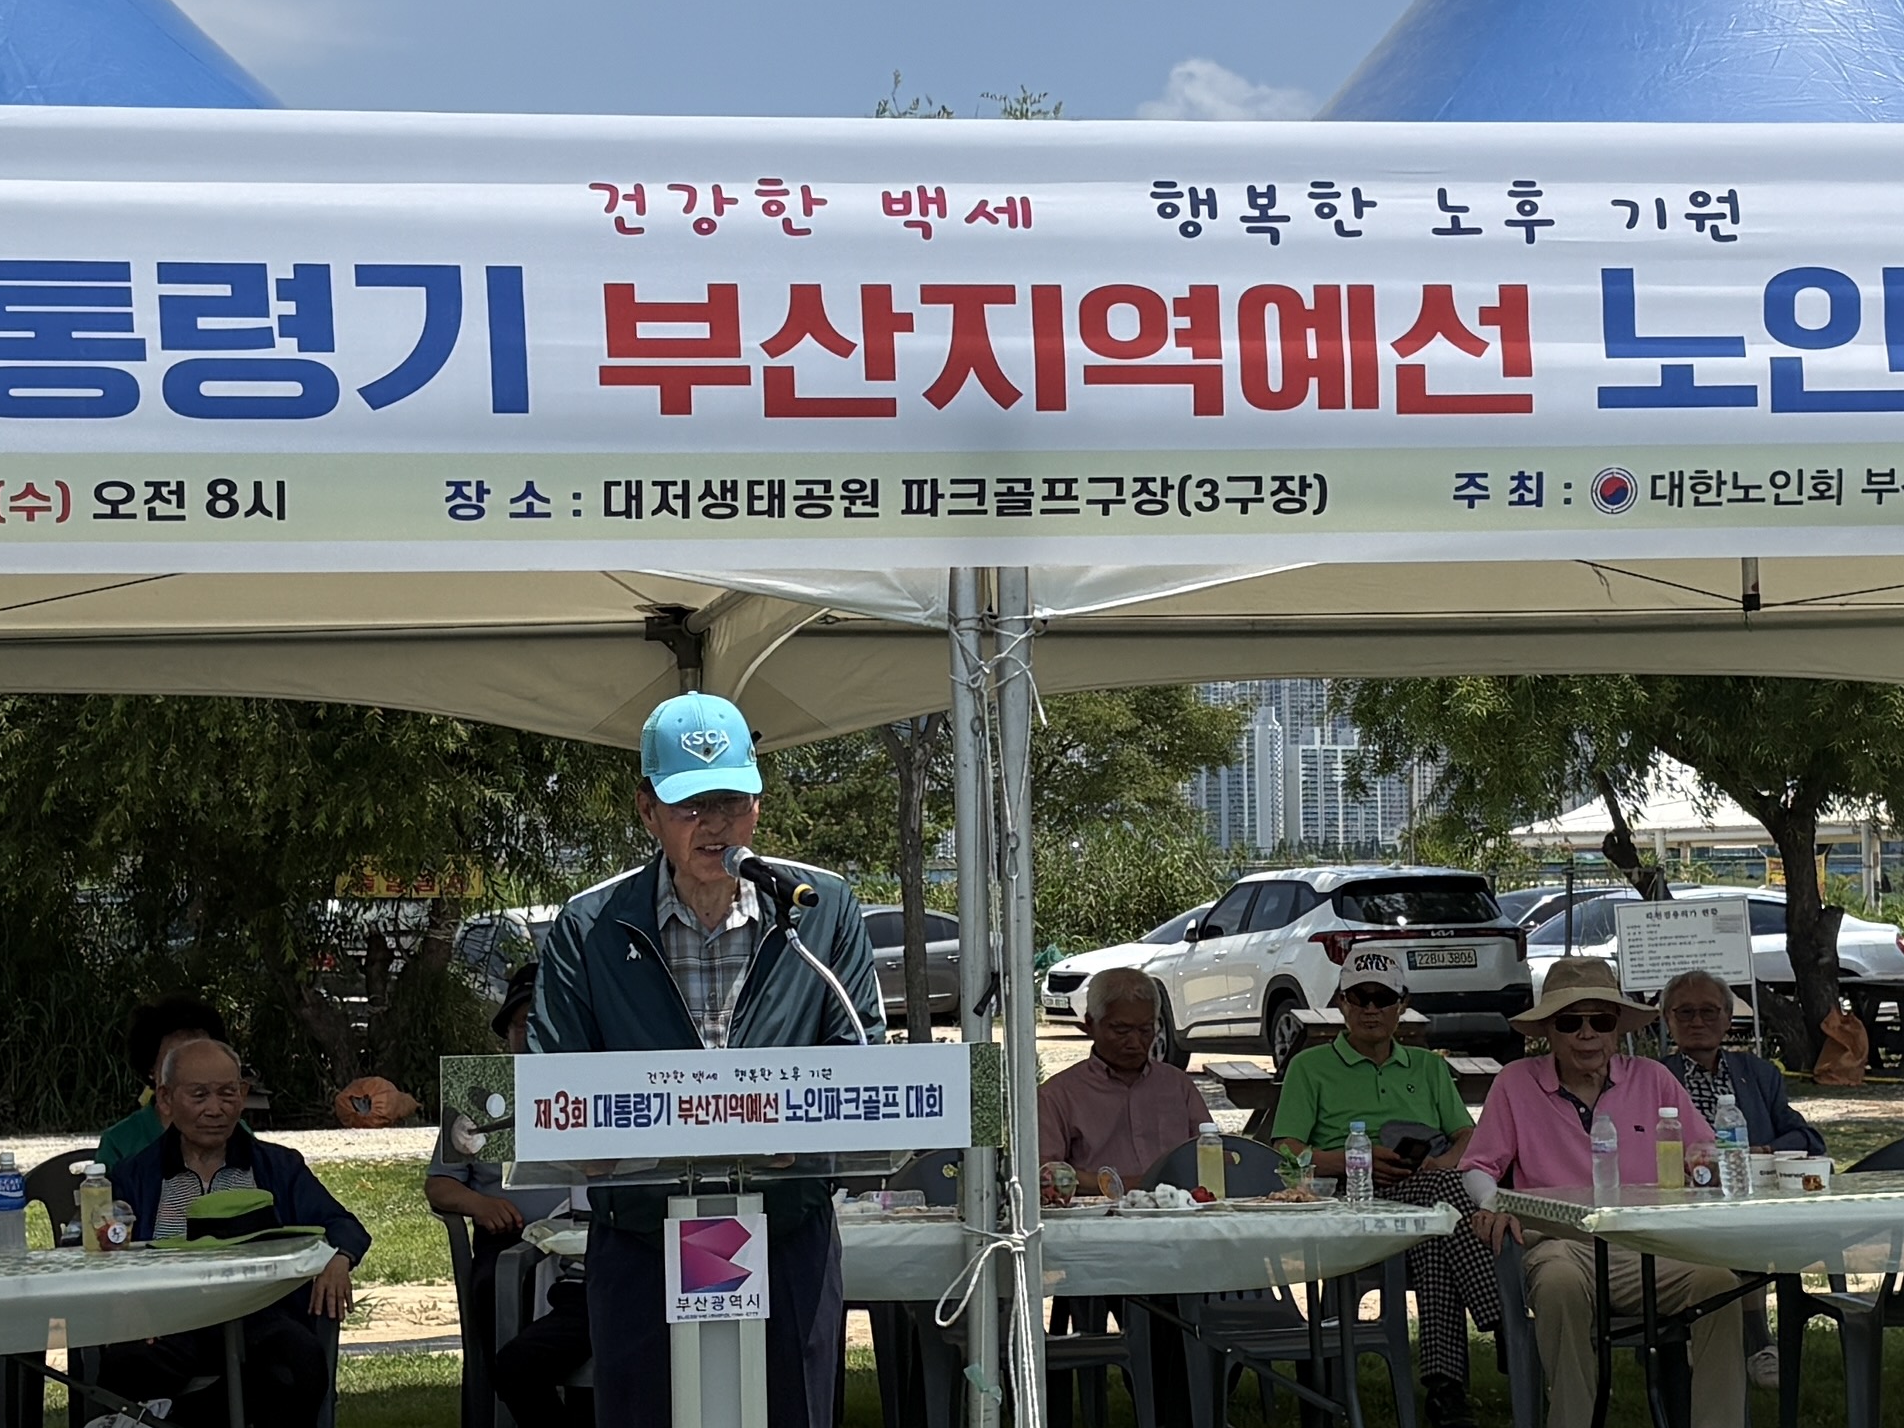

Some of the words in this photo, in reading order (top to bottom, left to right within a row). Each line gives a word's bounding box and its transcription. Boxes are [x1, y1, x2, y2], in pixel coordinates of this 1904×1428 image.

[587, 176, 829, 238] 건강한
[880, 183, 1034, 242] 백세
[1148, 179, 1379, 248] 행복한
[1427, 178, 1557, 246] 노후
[1609, 187, 1742, 244] 기원
[597, 281, 1535, 419] 부산지역예선
[91, 479, 188, 523] 오전
[204, 476, 287, 522] 8시
[602, 477, 881, 521] 대저생태공원
[899, 471, 1329, 519] 파크골프구장(3구장)
[1649, 466, 1844, 510] 대한노인회
[533, 1090, 588, 1131] 제3회
[593, 1091, 672, 1129] 대통령기
[677, 1092, 779, 1126] 부산지역예선
[784, 1085, 901, 1123] 노인파크골프
[905, 1083, 944, 1119] 대회
[676, 1293, 760, 1312] 부산광역시
